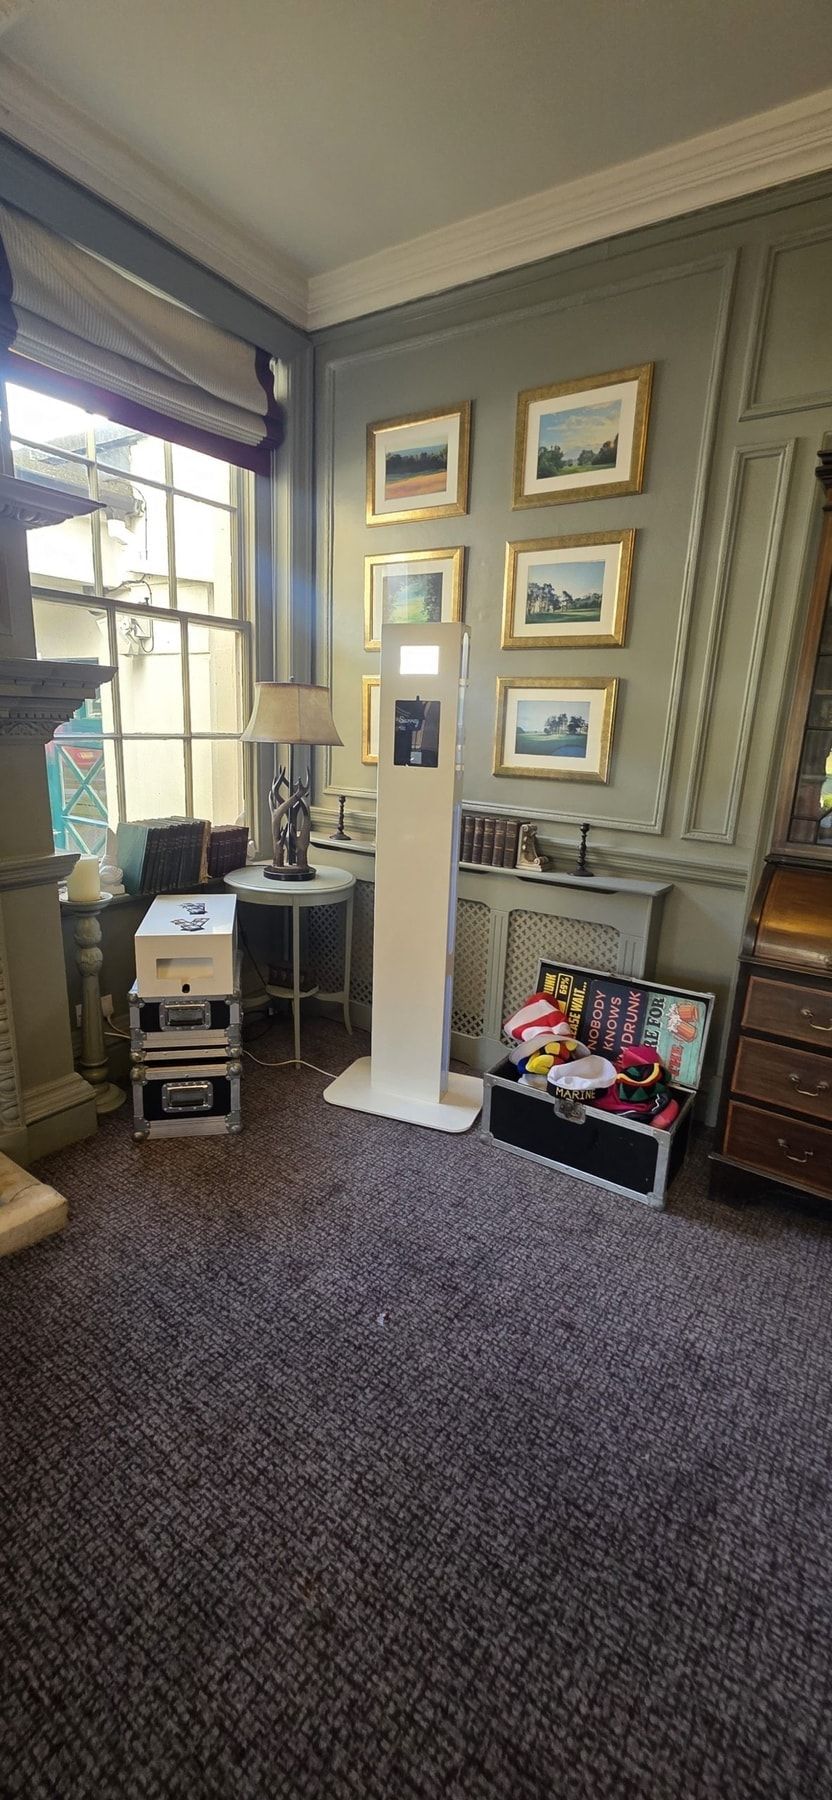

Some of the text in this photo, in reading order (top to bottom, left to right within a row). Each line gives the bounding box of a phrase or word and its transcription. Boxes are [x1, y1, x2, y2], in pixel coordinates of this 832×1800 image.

[569, 1011, 581, 1038] EASE
[588, 990, 606, 1050] NOBODY
[604, 996, 622, 1051] KNOWS
[621, 991, 641, 1044] DRUNK
[647, 997, 665, 1028] FOR
[555, 1087, 596, 1100] MARINE
